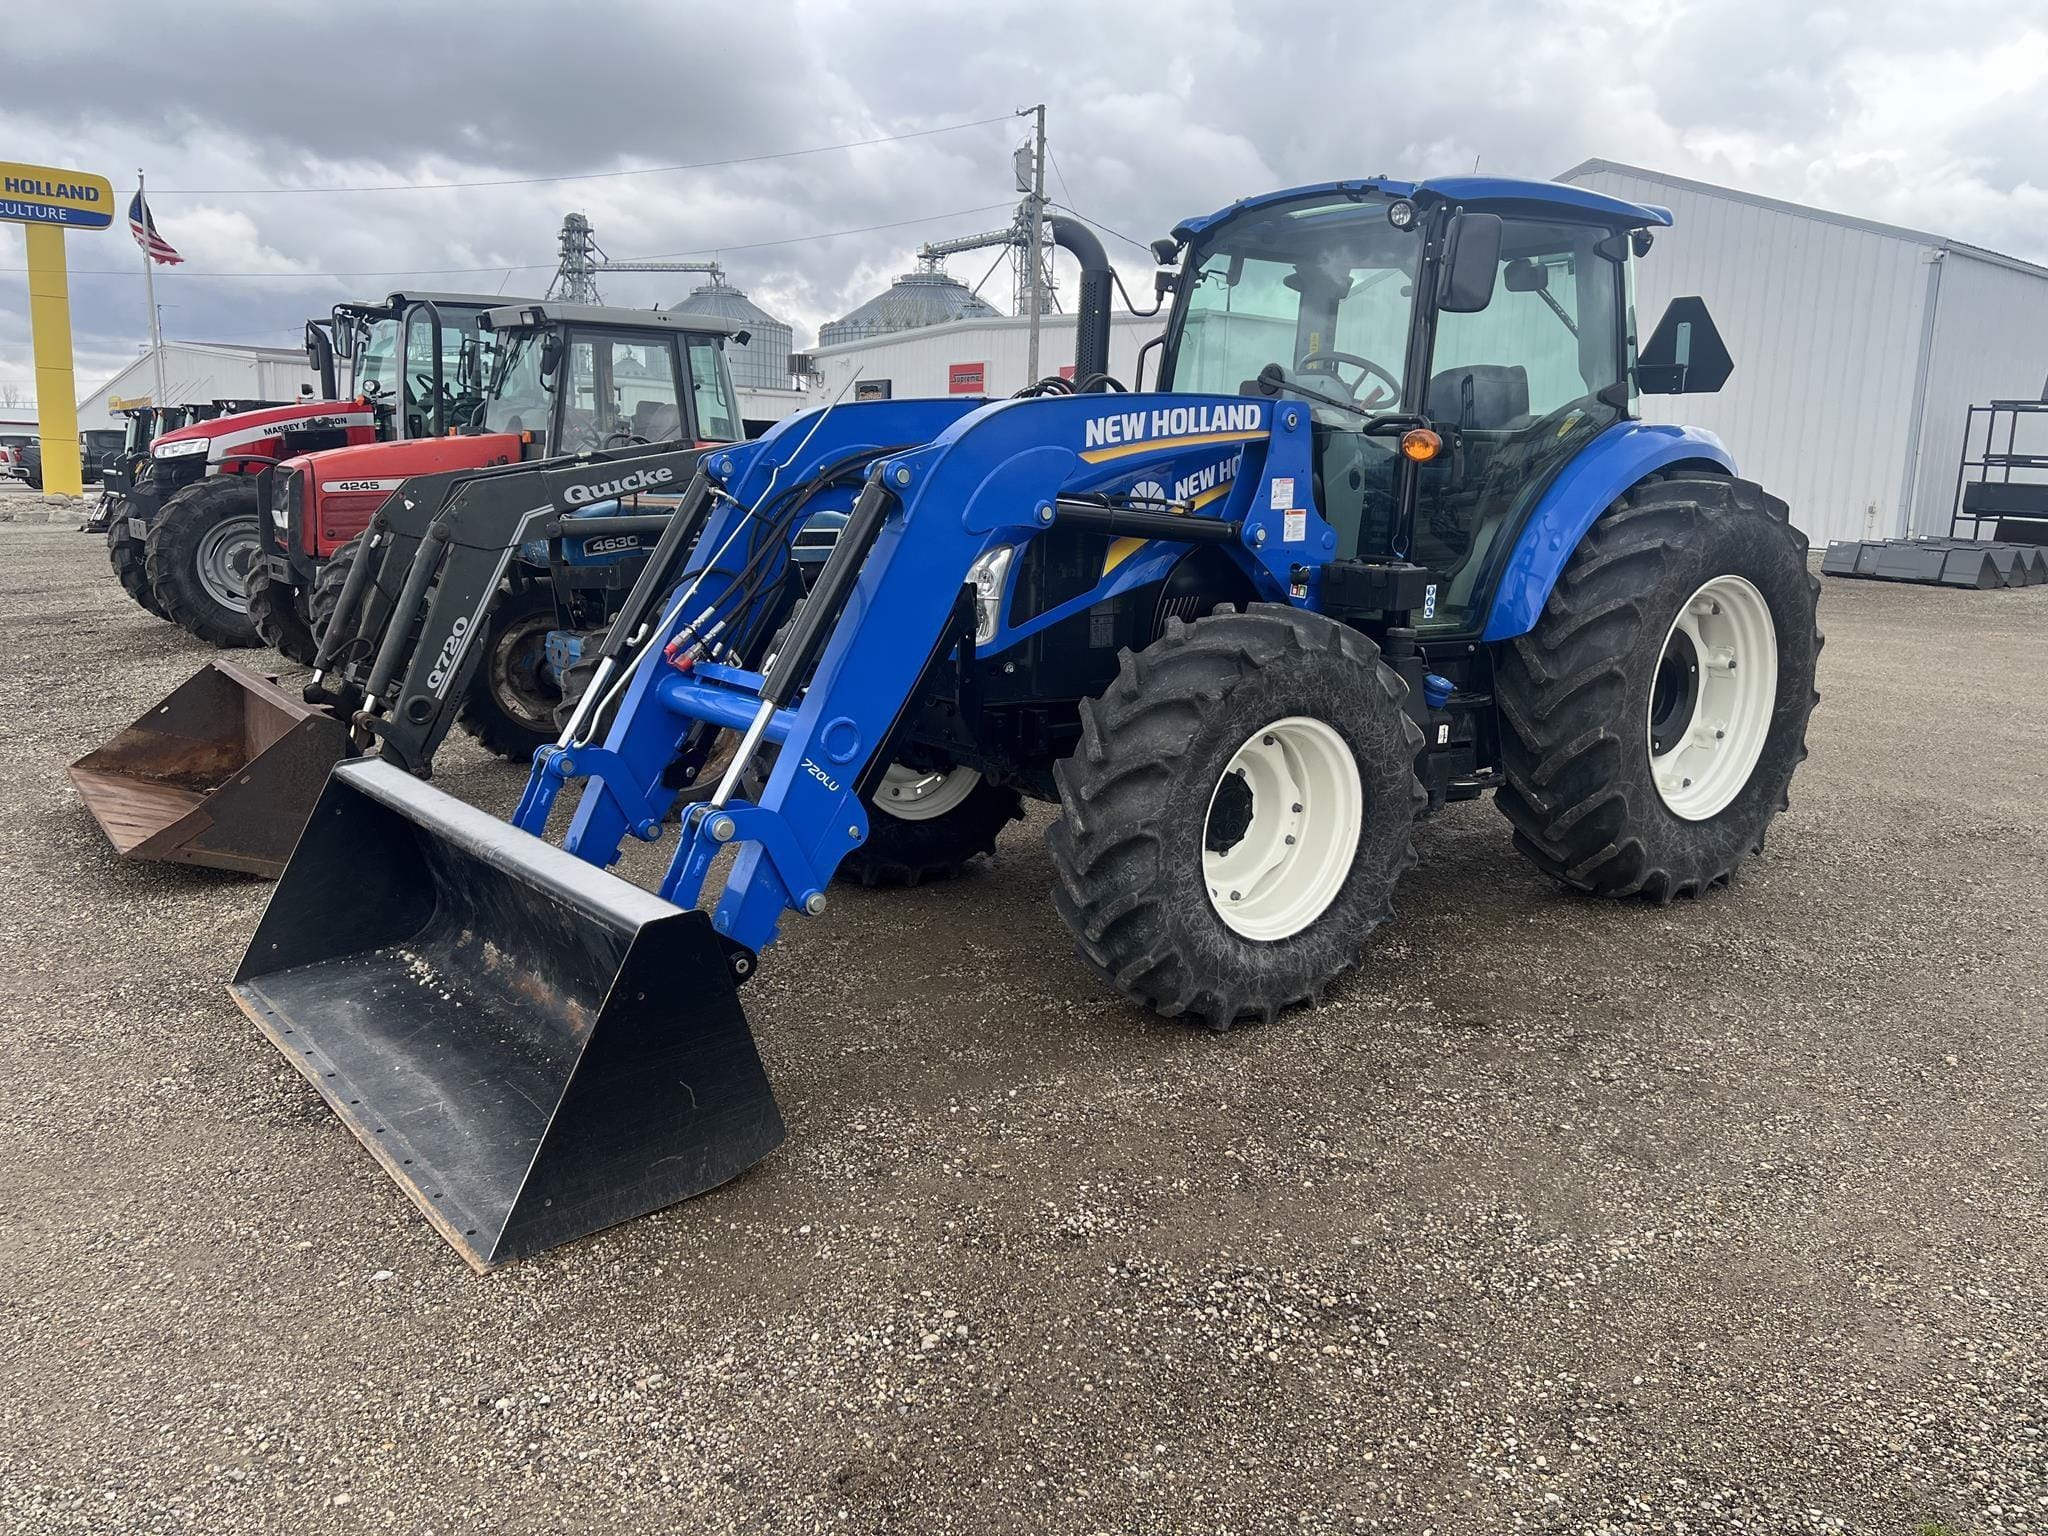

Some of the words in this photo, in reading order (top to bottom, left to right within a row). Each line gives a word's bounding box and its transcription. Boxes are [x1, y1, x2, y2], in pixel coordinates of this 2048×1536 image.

[5, 176, 99, 202] HOLLAND
[263, 423, 300, 436] MASSEY
[1085, 411, 1146, 448] NEW
[1151, 404, 1261, 437] HOLLAND
[340, 481, 380, 491] 4245
[563, 467, 673, 504] Quicke
[1174, 465, 1216, 501] NEW
[592, 535, 639, 551] 4630
[426, 616, 468, 689] Q720
[800, 758, 840, 791] 720LU
